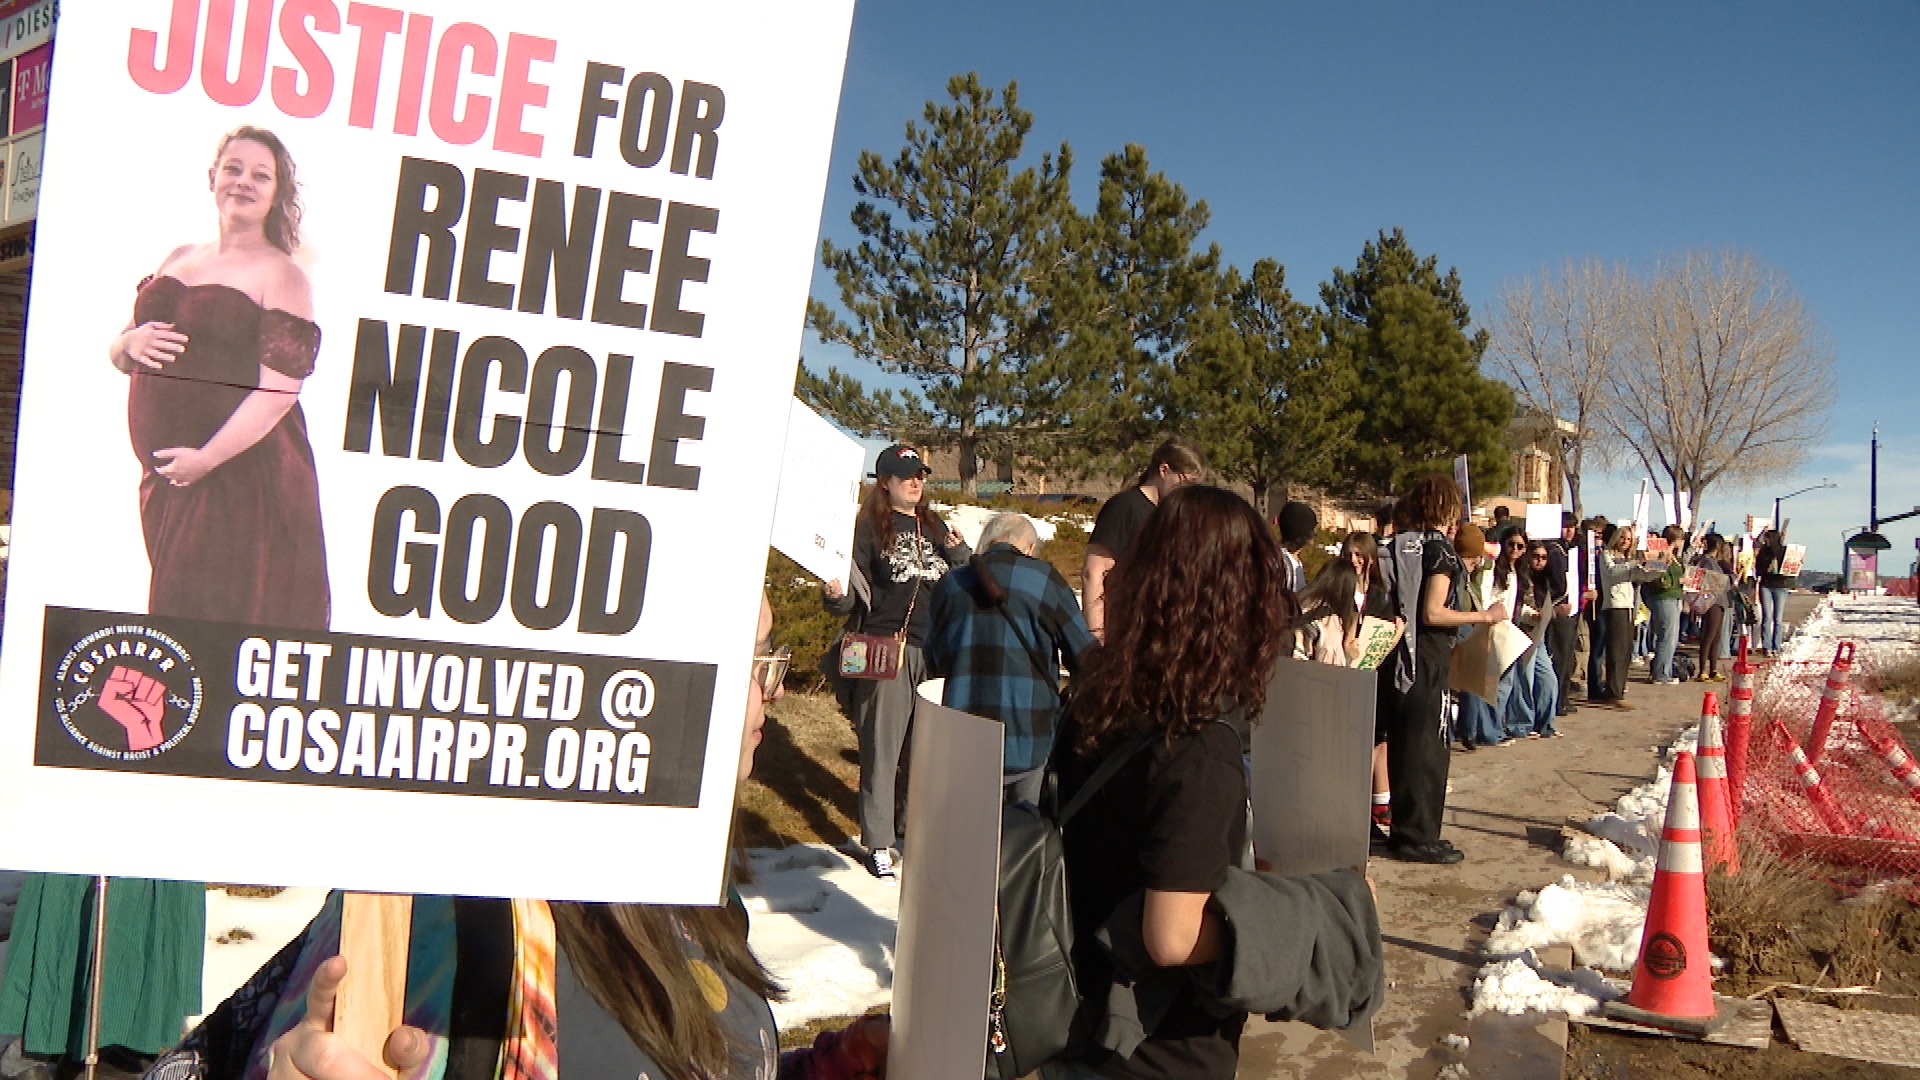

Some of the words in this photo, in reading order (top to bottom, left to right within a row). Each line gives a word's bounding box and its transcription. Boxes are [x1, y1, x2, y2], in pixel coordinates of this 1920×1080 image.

[127, 0, 558, 158] JUSTICE
[574, 61, 726, 181] FOR
[385, 155, 720, 339] RENEE
[343, 317, 715, 491] NICOLE
[367, 485, 653, 637] GOOD
[72, 640, 175, 684] COSAARPR
[236, 637, 332, 703] GET
[345, 647, 585, 721] INVOLVED
[601, 669, 655, 731] @
[227, 701, 651, 793] COSAARPR.ORG
